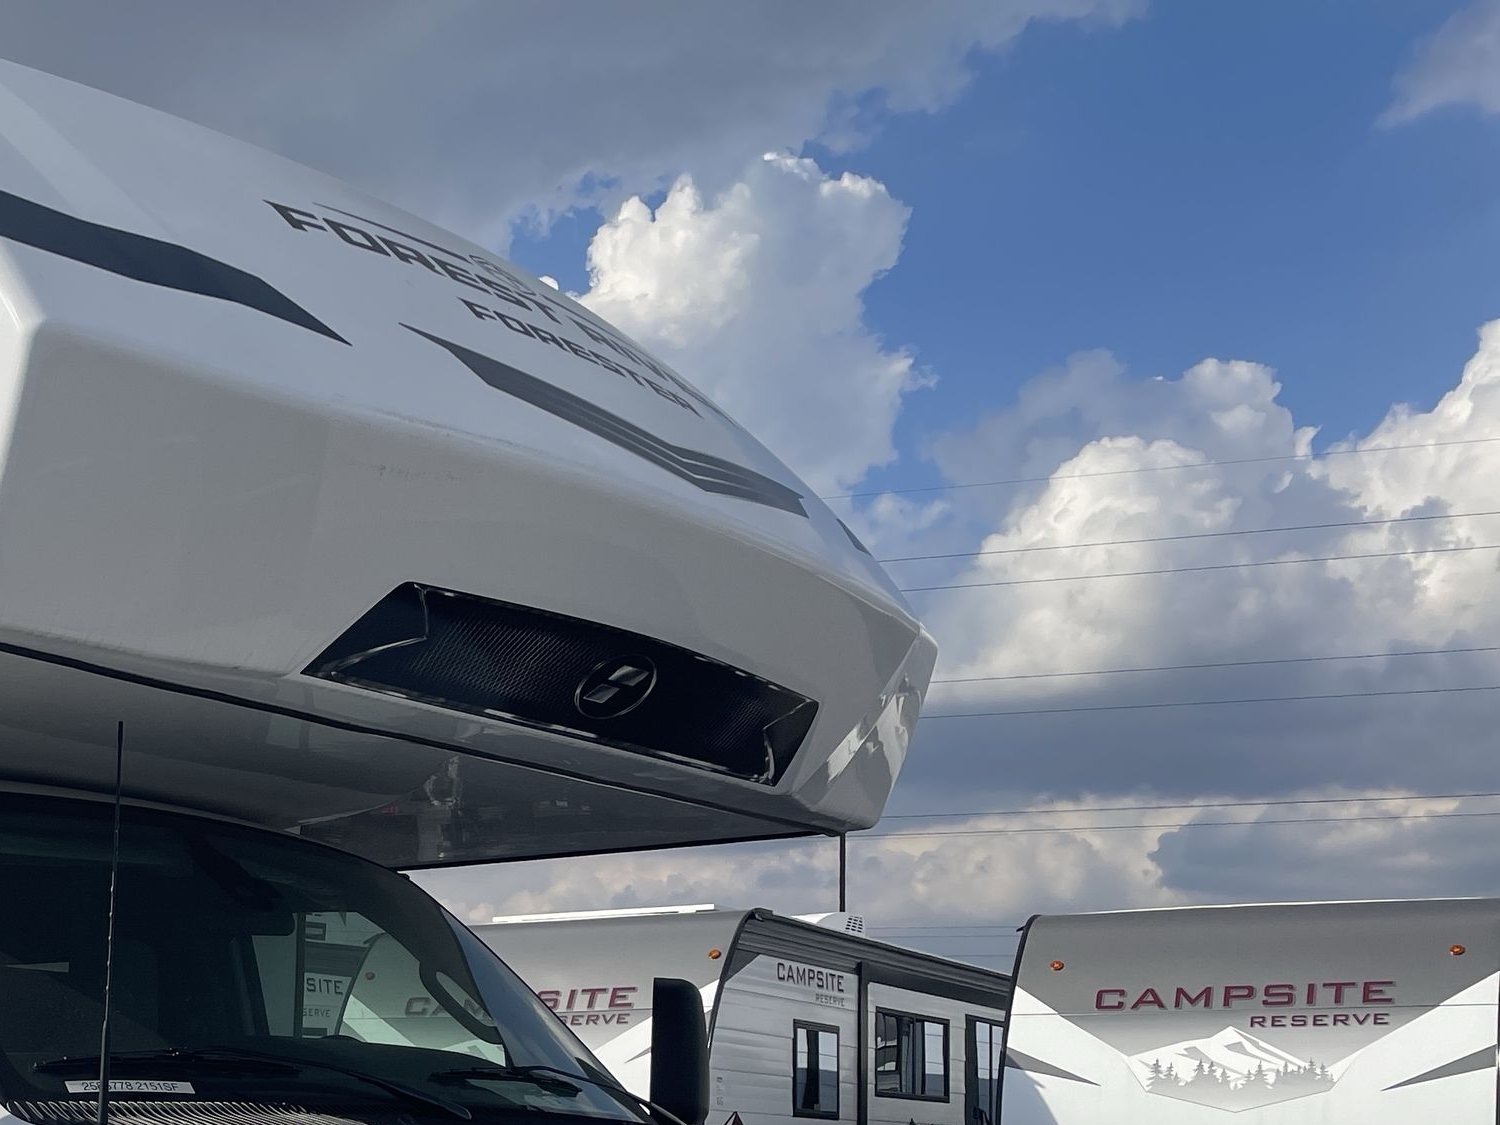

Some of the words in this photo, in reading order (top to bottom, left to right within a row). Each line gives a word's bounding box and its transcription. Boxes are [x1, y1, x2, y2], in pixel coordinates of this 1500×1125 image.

[262, 199, 561, 325] FOREST
[457, 296, 704, 419] FORESTER
[776, 962, 845, 993] CAMPSITE
[1095, 981, 1396, 1010] CAMPSITE
[1249, 1012, 1390, 1028] RESERVE
